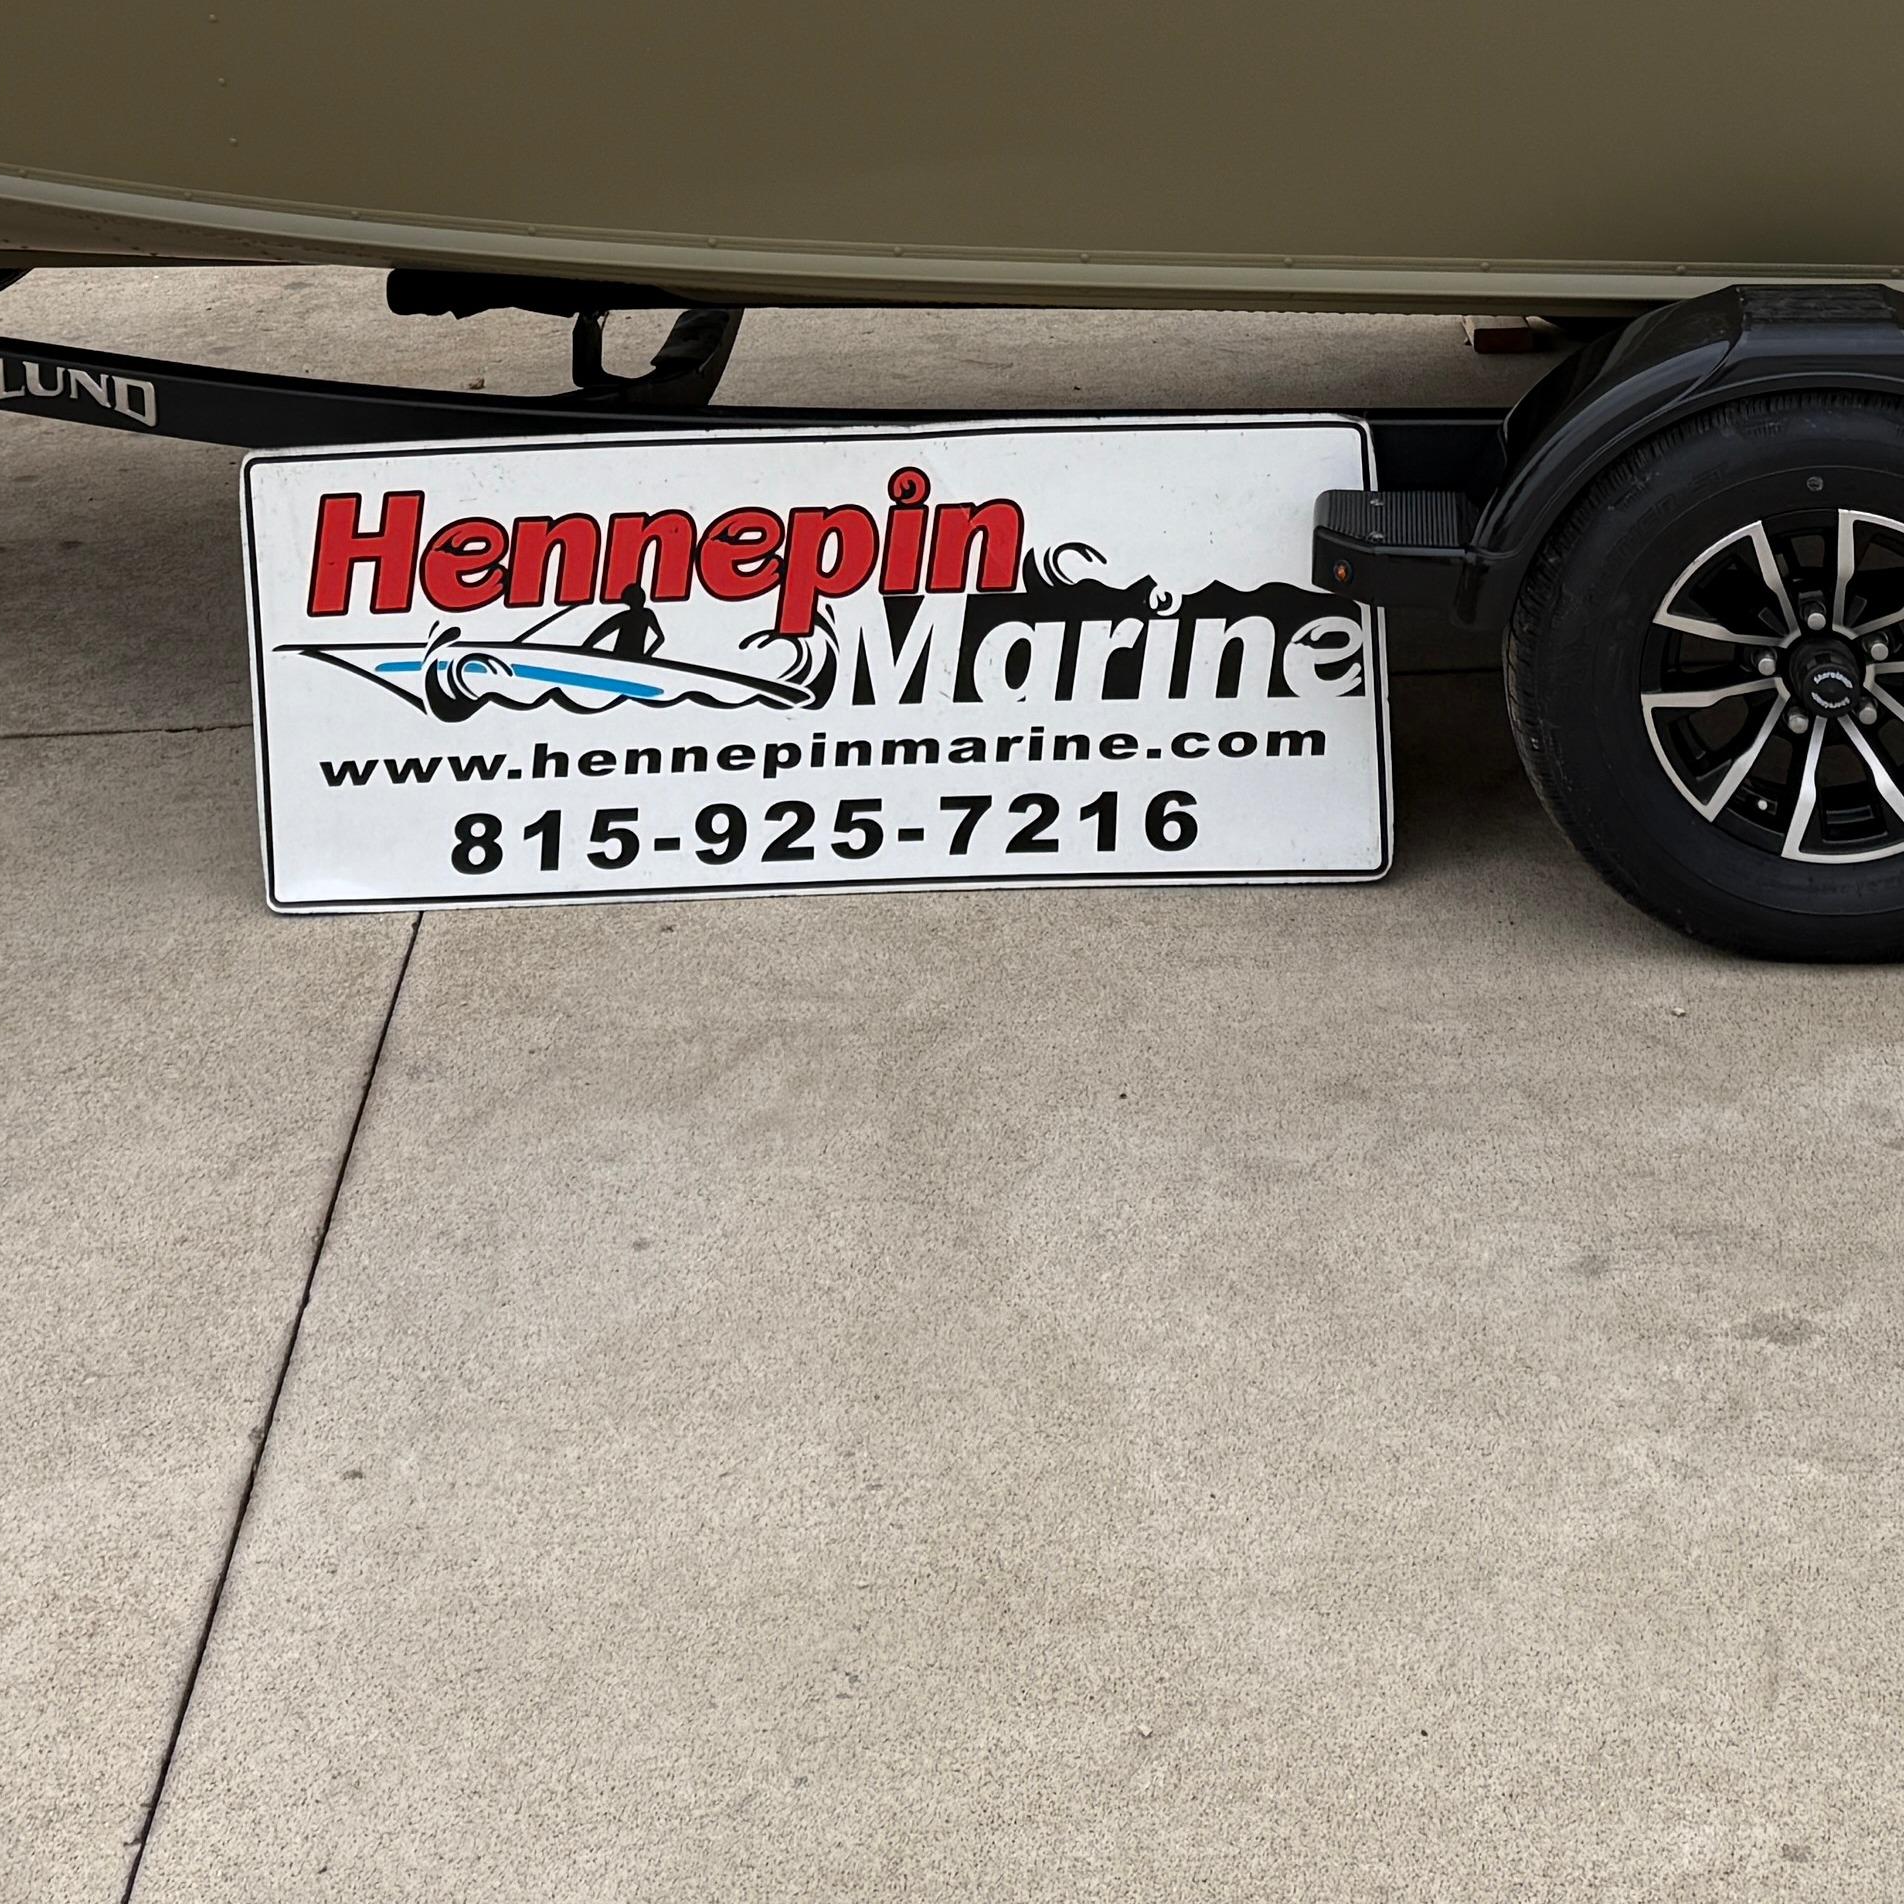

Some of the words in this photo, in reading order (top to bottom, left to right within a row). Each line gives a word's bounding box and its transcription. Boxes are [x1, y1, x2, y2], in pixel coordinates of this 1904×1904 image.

[305, 465, 1026, 639] Hennepin
[836, 586, 1366, 708] Marine
[318, 724, 1329, 787] www.hennepinmarine.com
[449, 789, 1201, 876] 815-925-7216
